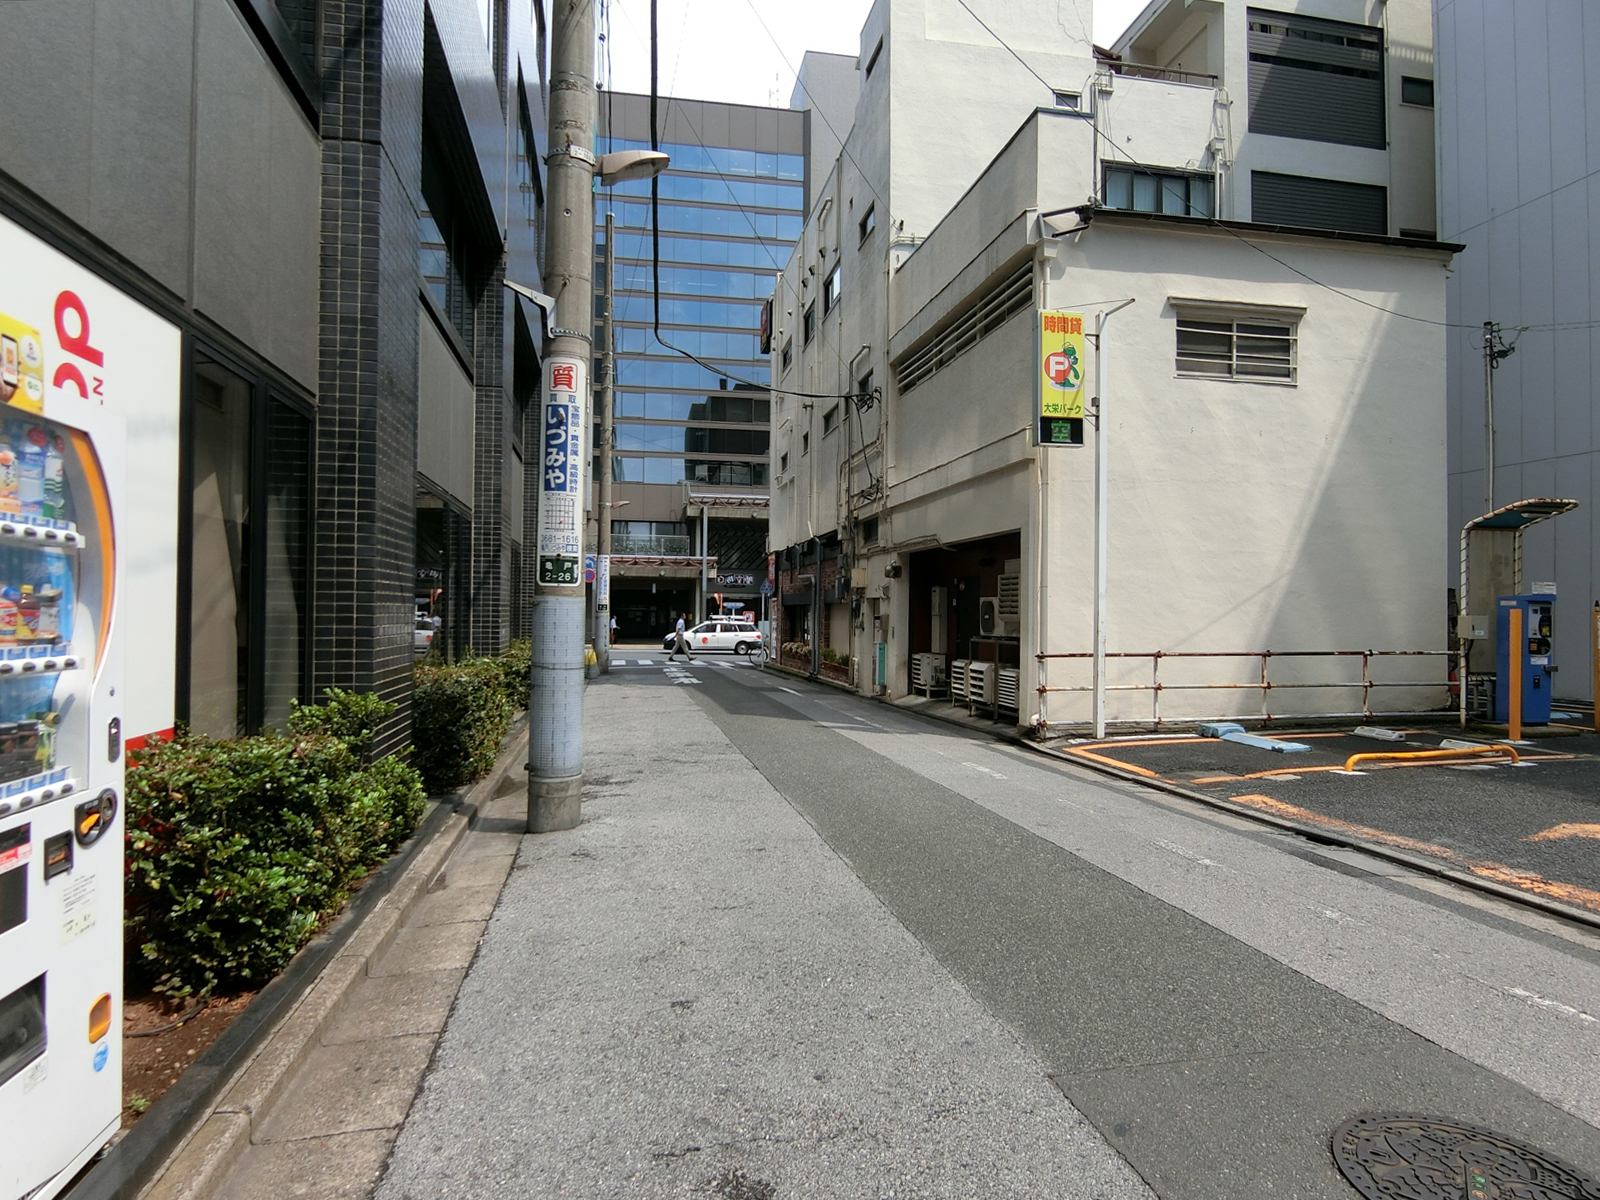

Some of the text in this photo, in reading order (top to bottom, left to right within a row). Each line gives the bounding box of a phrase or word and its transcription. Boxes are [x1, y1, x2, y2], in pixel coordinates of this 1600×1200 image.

[1043, 315, 1082, 335] 時間貸
[1049, 356, 1069, 377] P
[552, 365, 574, 389] 質
[1043, 402, 1082, 415] 大栄パーク
[546, 406, 567, 488] いづみや
[541, 534, 579, 543] 3681-1616
[545, 561, 572, 570] 亀戸
[545, 572, 571, 581] 2-26
